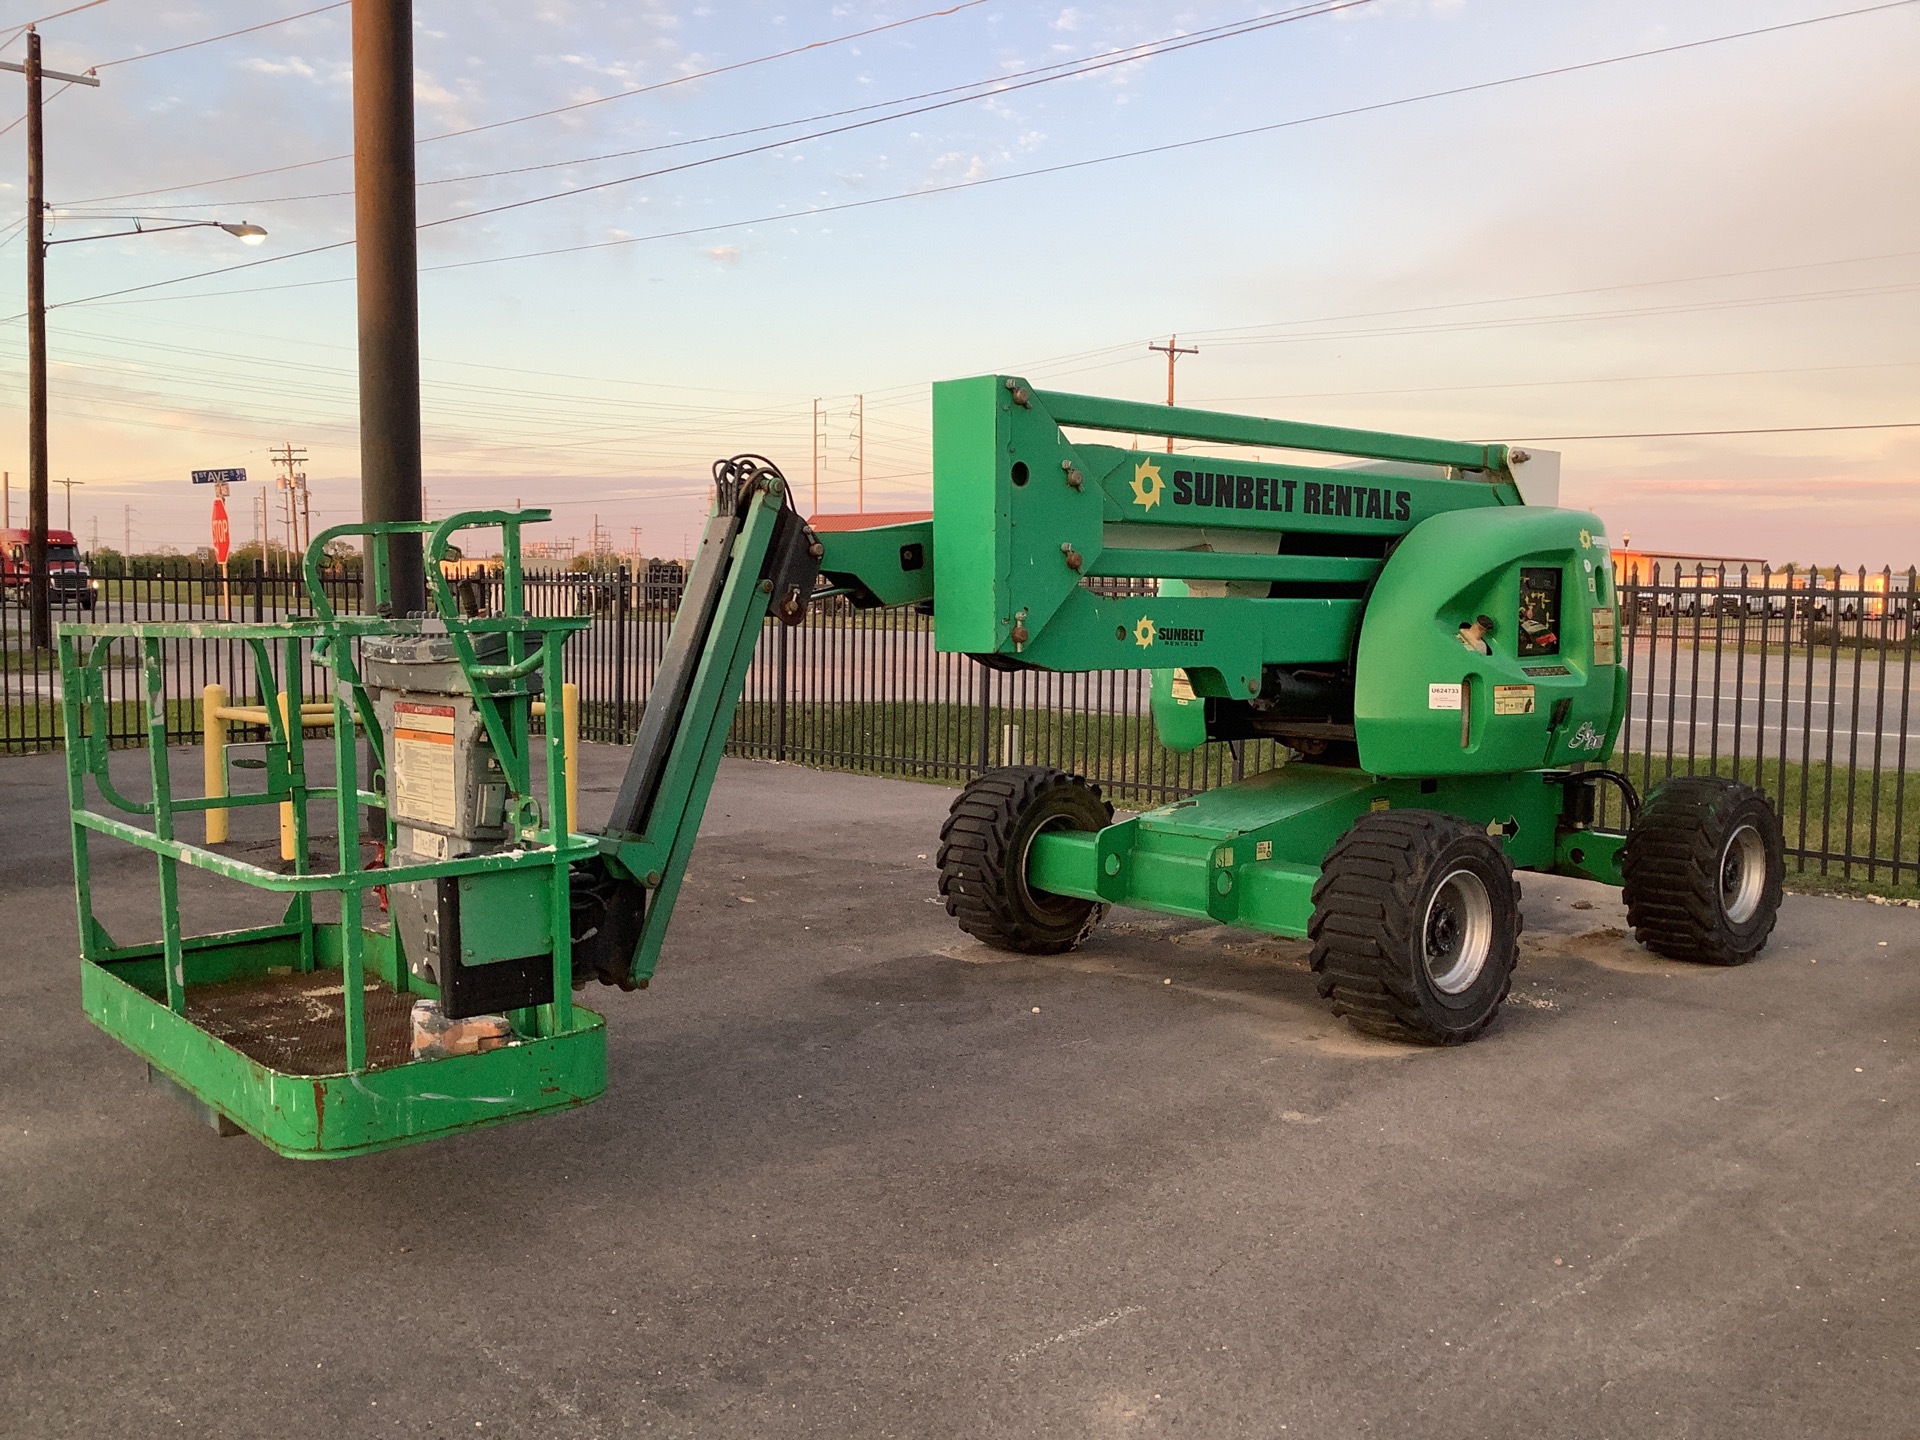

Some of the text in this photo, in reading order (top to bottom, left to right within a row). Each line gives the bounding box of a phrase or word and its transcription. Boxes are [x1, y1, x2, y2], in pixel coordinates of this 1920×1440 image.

[207, 470, 230, 482] AVE
[1173, 470, 1411, 521] SUNBELT RENTALS
[213, 519, 228, 543] STOP
[1158, 627, 1205, 641] SUNBELT
